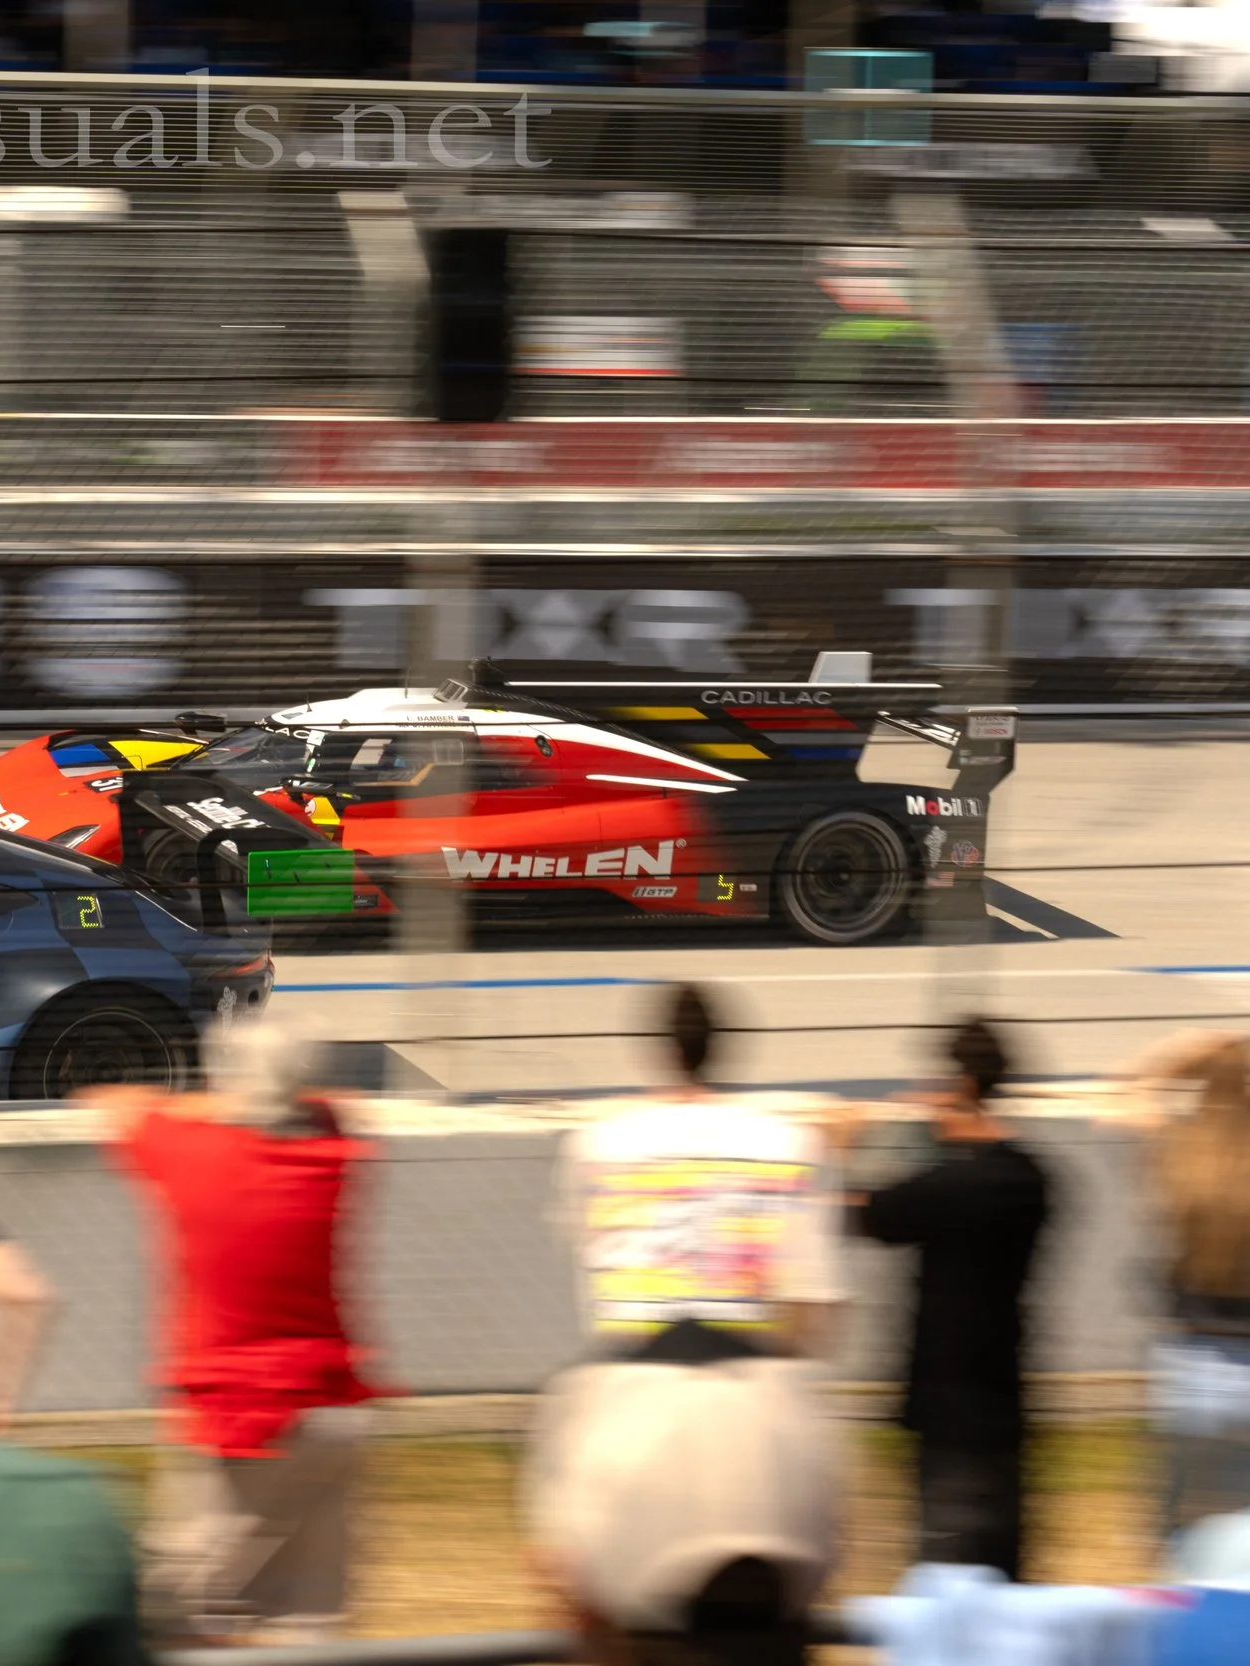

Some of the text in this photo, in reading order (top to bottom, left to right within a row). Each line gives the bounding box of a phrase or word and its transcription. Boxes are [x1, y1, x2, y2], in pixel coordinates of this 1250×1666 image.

[701, 689, 832, 705] CADILLAC
[906, 795, 963, 817] Mobil
[440, 839, 674, 881] WHELEN
[76, 895, 99, 928] 2
